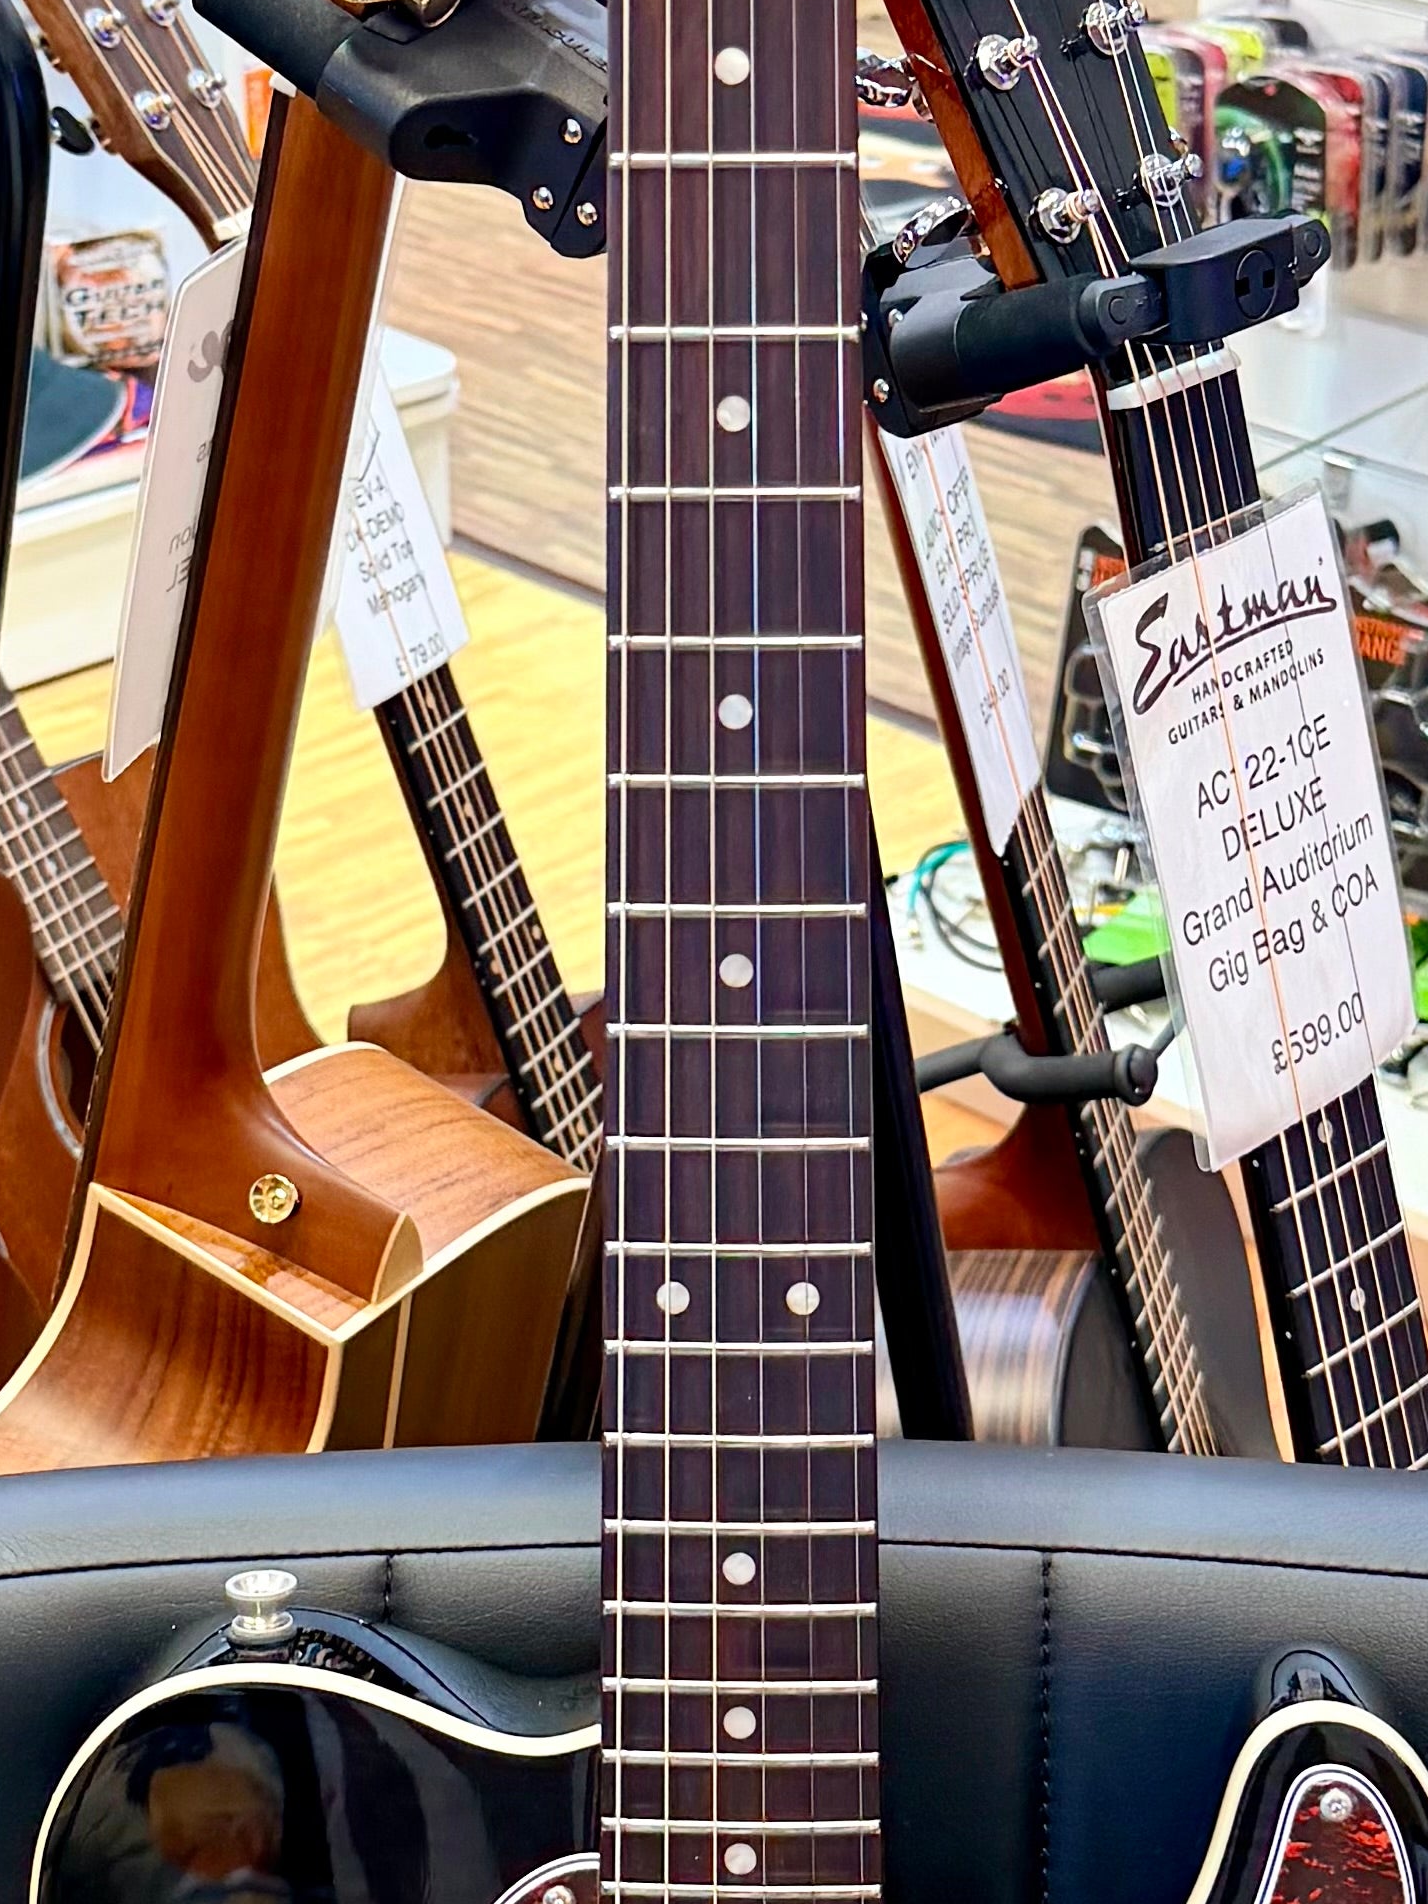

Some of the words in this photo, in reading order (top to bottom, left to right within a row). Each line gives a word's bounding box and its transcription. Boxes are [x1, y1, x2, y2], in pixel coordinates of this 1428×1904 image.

[395, 633, 444, 678] £79.00
[1132, 570, 1337, 716] Eastman
[1191, 639, 1294, 704] HANDCRAFTED
[1168, 699, 1226, 746] GUITARS
[1232, 692, 1245, 712] &
[1248, 648, 1325, 707] MANDOLINS
[1197, 713, 1332, 819] AC22-1CE
[1221, 777, 1329, 863] DELUXE
[1183, 877, 1252, 948] Grand
[1261, 810, 1375, 902] Auditorium
[1209, 947, 1249, 995] Gig
[1254, 916, 1305, 966] Bag
[1310, 903, 1328, 934] &
[1332, 863, 1380, 918] COA
[1271, 991, 1365, 1074] £599.00
